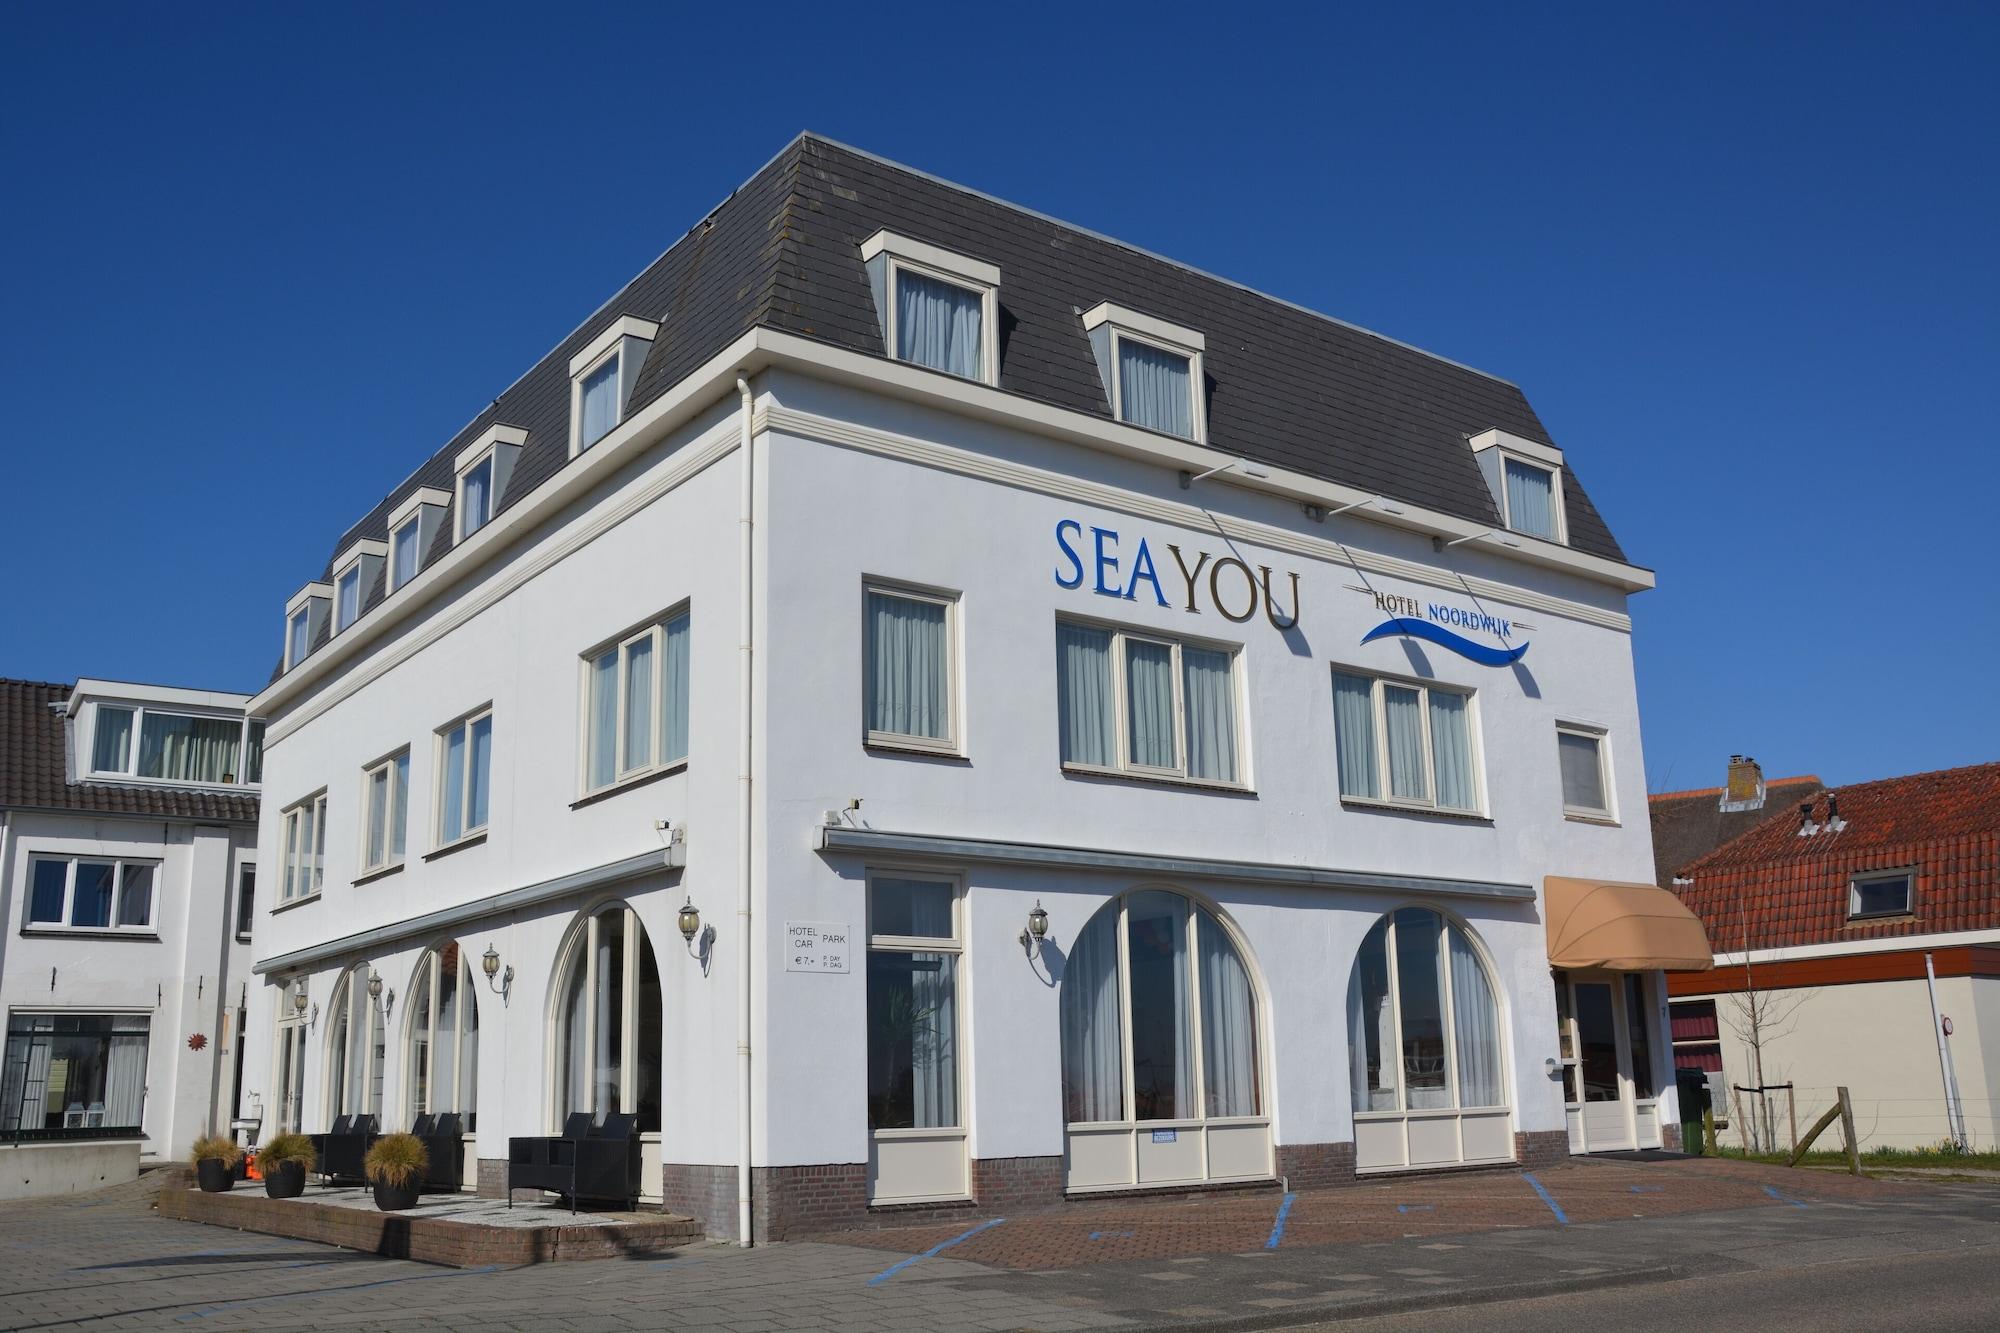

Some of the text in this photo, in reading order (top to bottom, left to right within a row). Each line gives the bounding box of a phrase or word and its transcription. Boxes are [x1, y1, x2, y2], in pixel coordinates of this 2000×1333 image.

[1374, 591, 1512, 638] HOTEL NOORDWIJK
[789, 927, 818, 936] HOTEL
[822, 934, 846, 943] PARK
[794, 939, 813, 948] CAR
